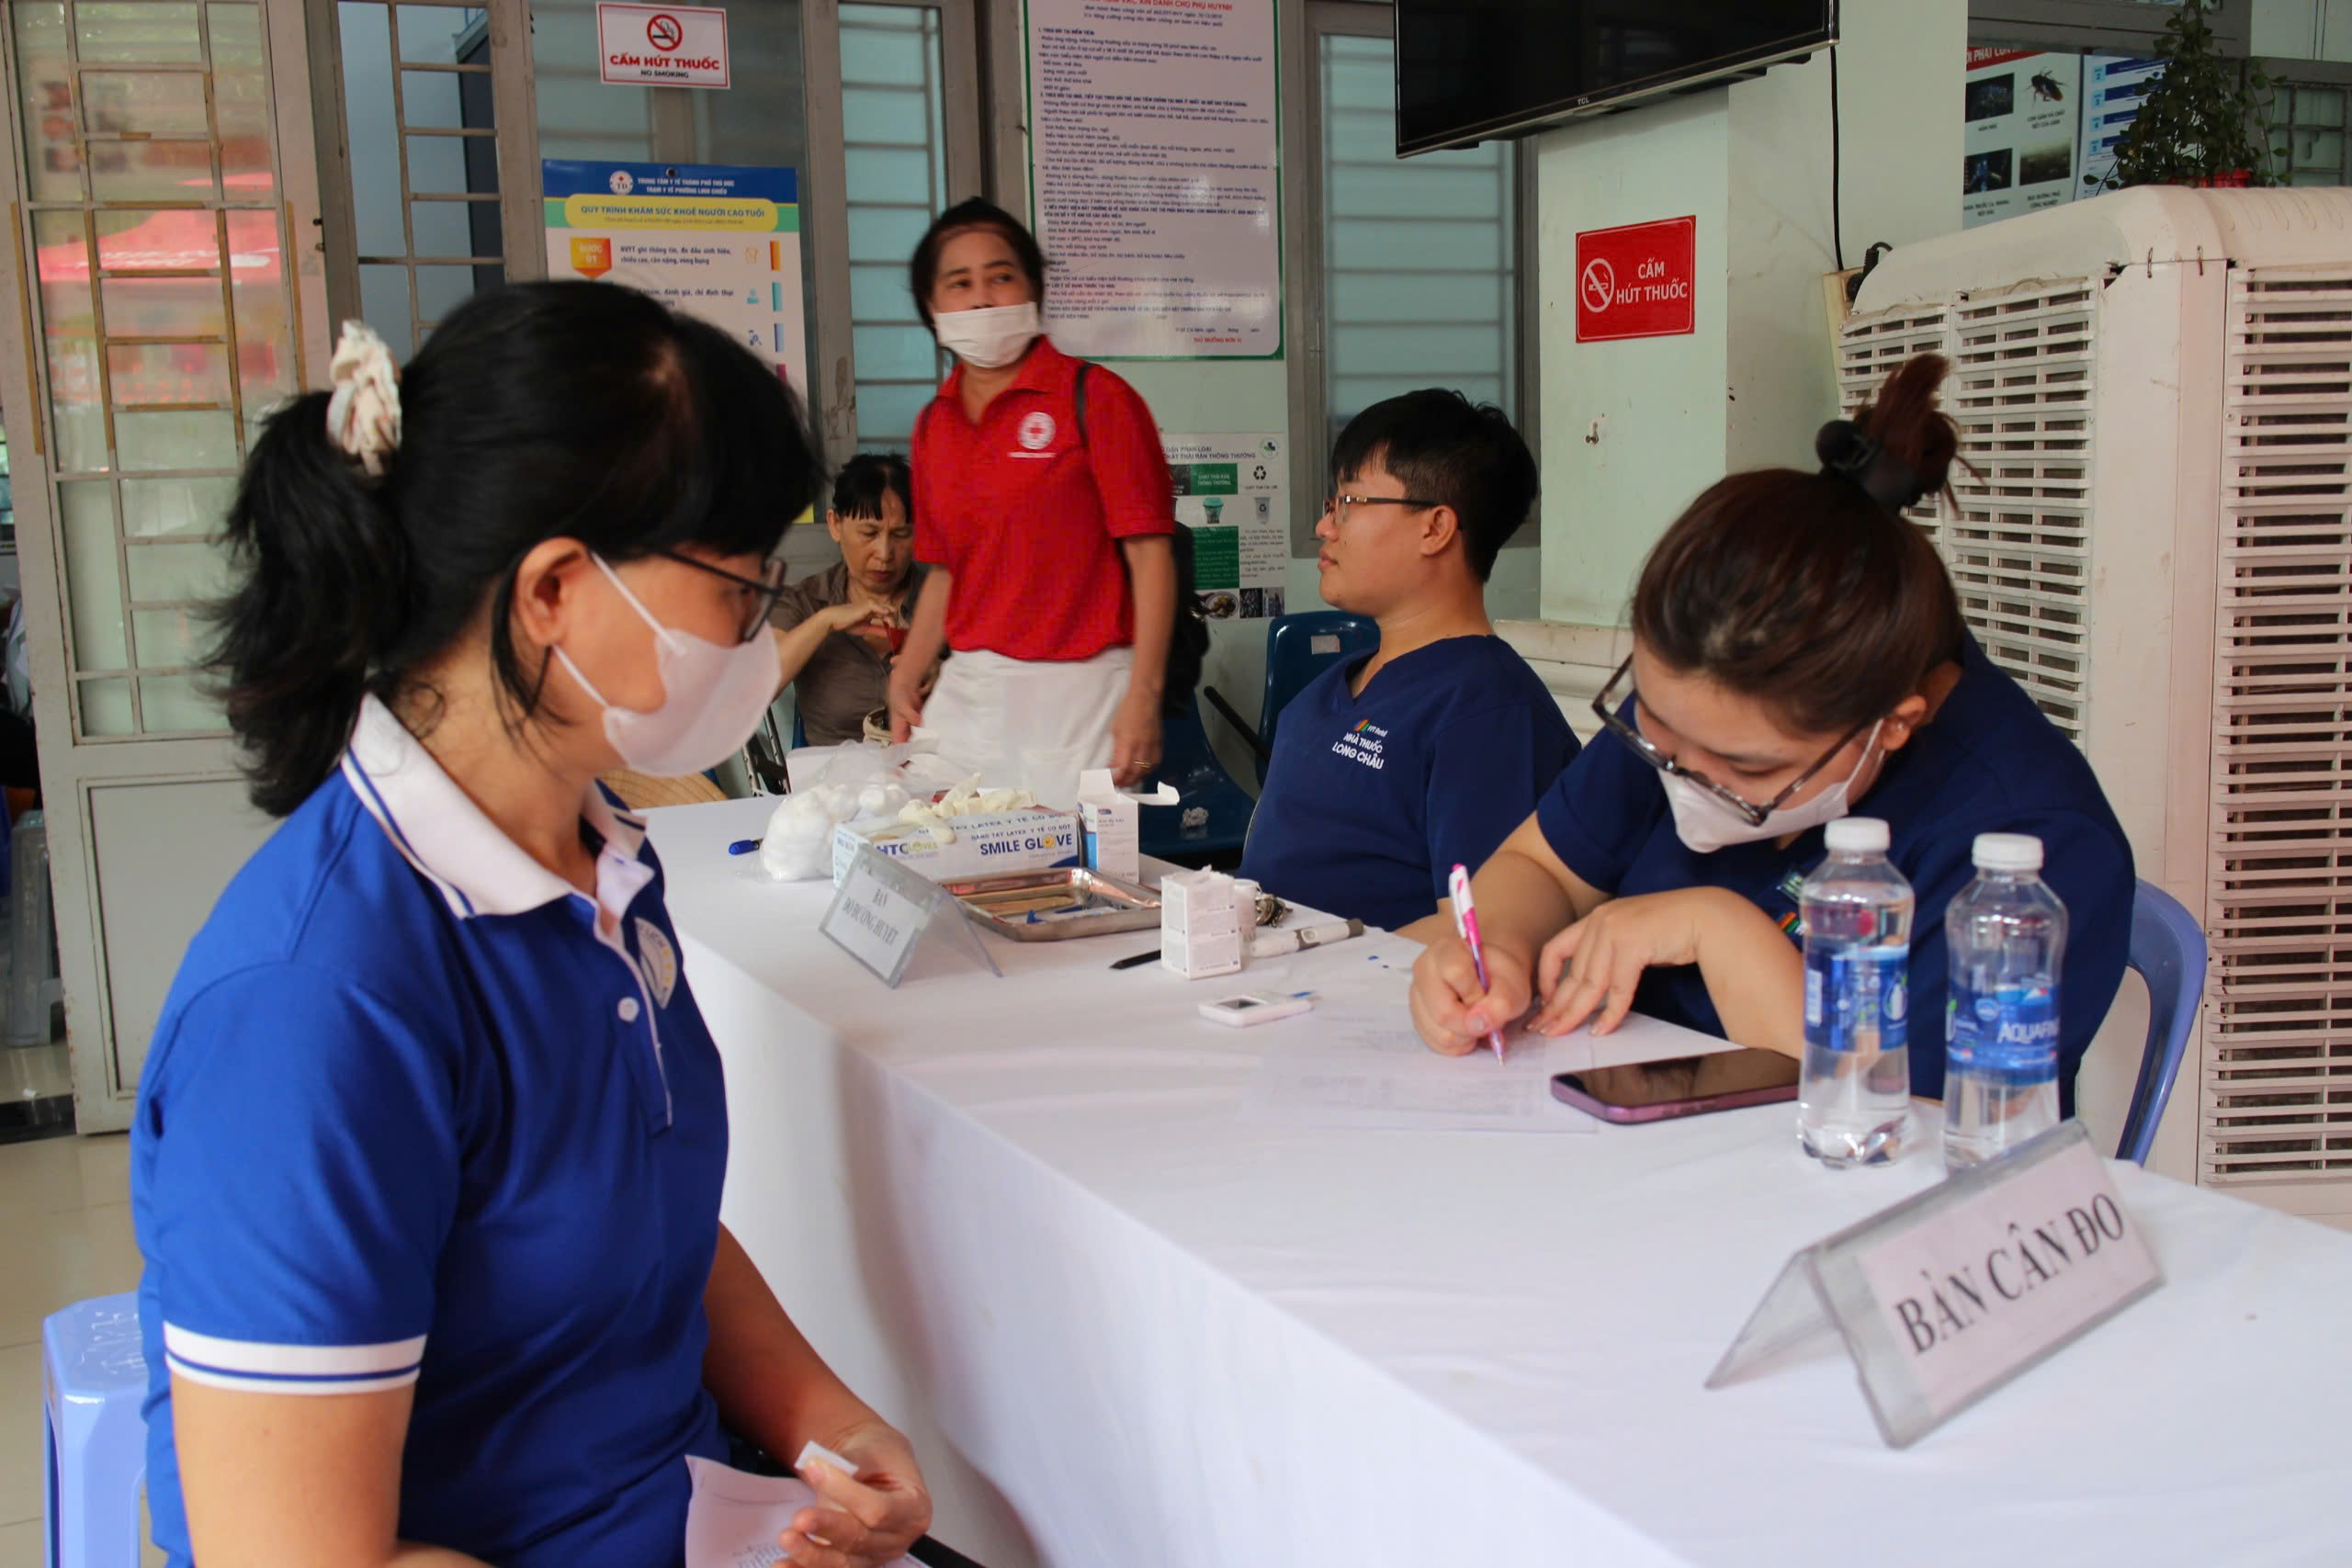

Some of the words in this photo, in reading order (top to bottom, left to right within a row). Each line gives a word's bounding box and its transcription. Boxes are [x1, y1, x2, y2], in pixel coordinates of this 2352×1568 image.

[610, 51, 640, 66] CẤM
[644, 54, 671, 68] HÚT
[674, 56, 719, 70] THUỐC
[1577, 96, 1589, 106] TCL
[581, 205, 598, 213] QUY
[602, 205, 627, 213] TRÌNH
[628, 205, 653, 214] KHÁM
[656, 205, 670, 214] SỨC
[698, 207, 725, 217] NGƯỜI
[728, 209, 743, 217] CAO
[1638, 257, 1665, 279] CẤM
[1616, 283, 1642, 305] HÚT
[1644, 278, 1688, 301] THUỐC
[1343, 732, 1360, 745] NHÀ
[1359, 738, 1384, 753] THUỐC
[1331, 741, 1357, 759] LONG
[1357, 750, 1385, 770] CHÂU
[980, 840, 1020, 856] SMILE
[1024, 833, 1072, 851] GLOVE
[1894, 1268, 1989, 1355] BÀN
[1986, 1222, 2073, 1302] CÂN
[2065, 1192, 2125, 1258] ĐO
